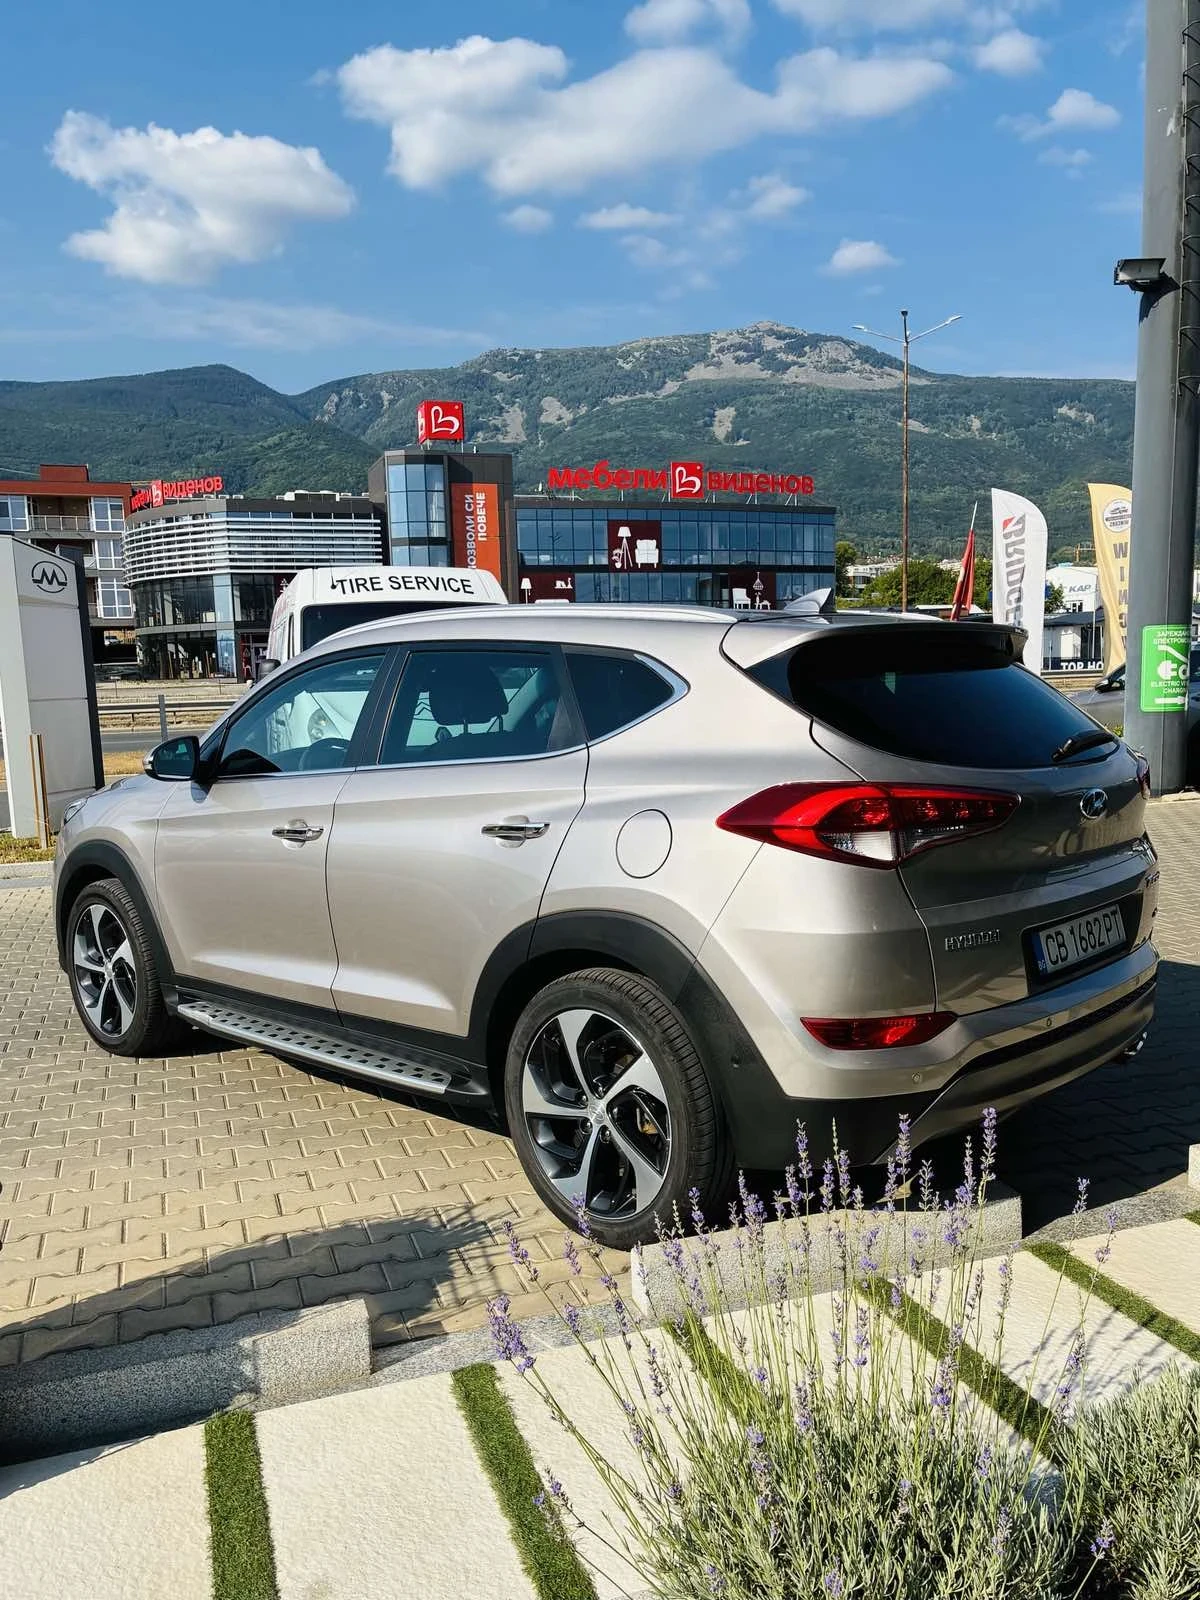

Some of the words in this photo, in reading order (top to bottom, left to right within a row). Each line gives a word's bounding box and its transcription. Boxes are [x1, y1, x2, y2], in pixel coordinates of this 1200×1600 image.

[163, 476, 223, 498] виденов
[547, 459, 668, 490] мебели
[707, 471, 814, 495] виденов
[475, 492, 488, 541] ПОВЕЧЕ
[336, 576, 384, 595] TIRE
[388, 575, 475, 594] SERVICE
